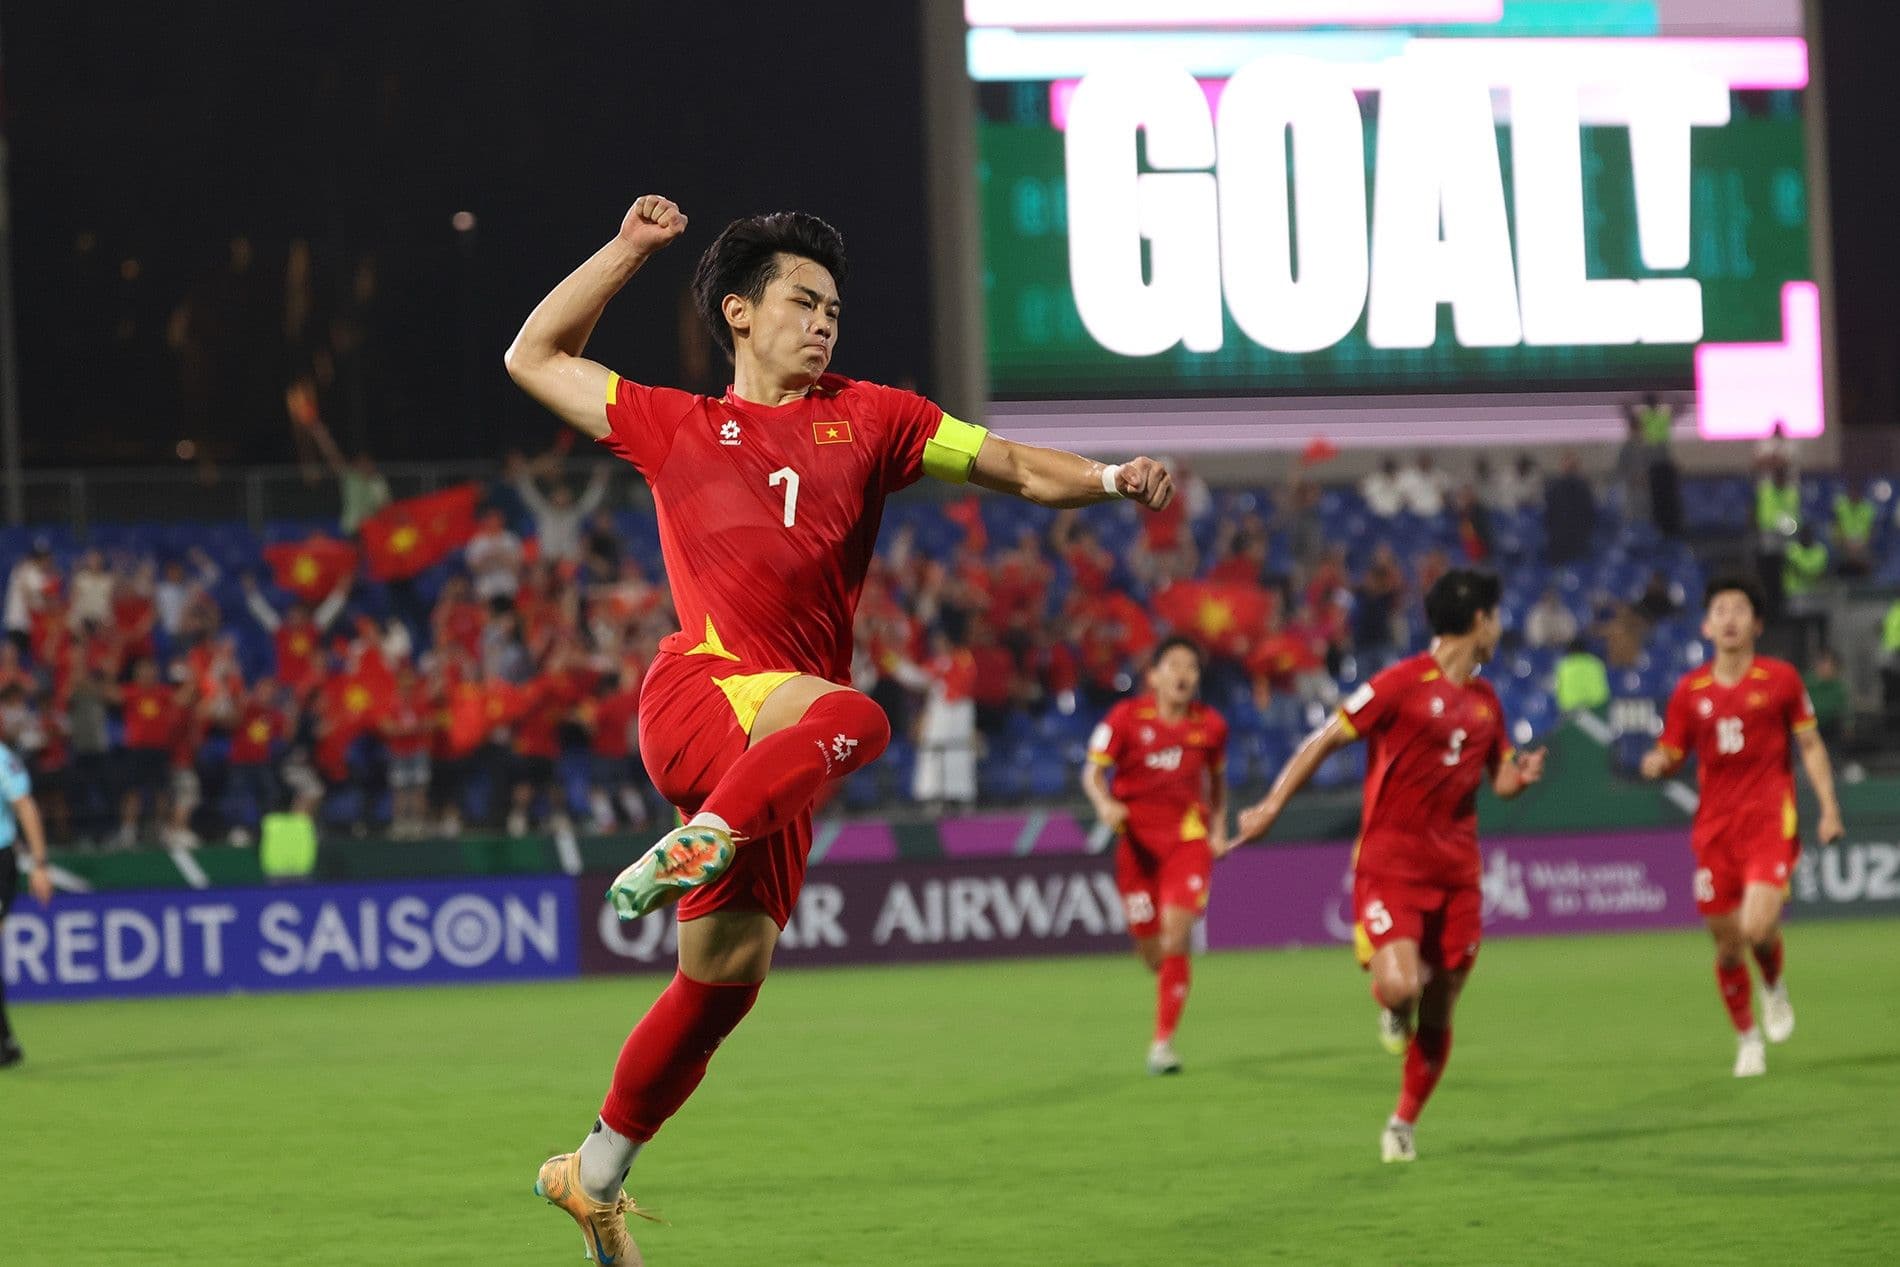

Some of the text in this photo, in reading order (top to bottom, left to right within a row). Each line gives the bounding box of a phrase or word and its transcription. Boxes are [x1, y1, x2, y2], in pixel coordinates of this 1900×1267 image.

[1064, 56, 1731, 357] GOAL!
[258, 892, 559, 976] SAISON
[1365, 898, 1394, 936] 5
